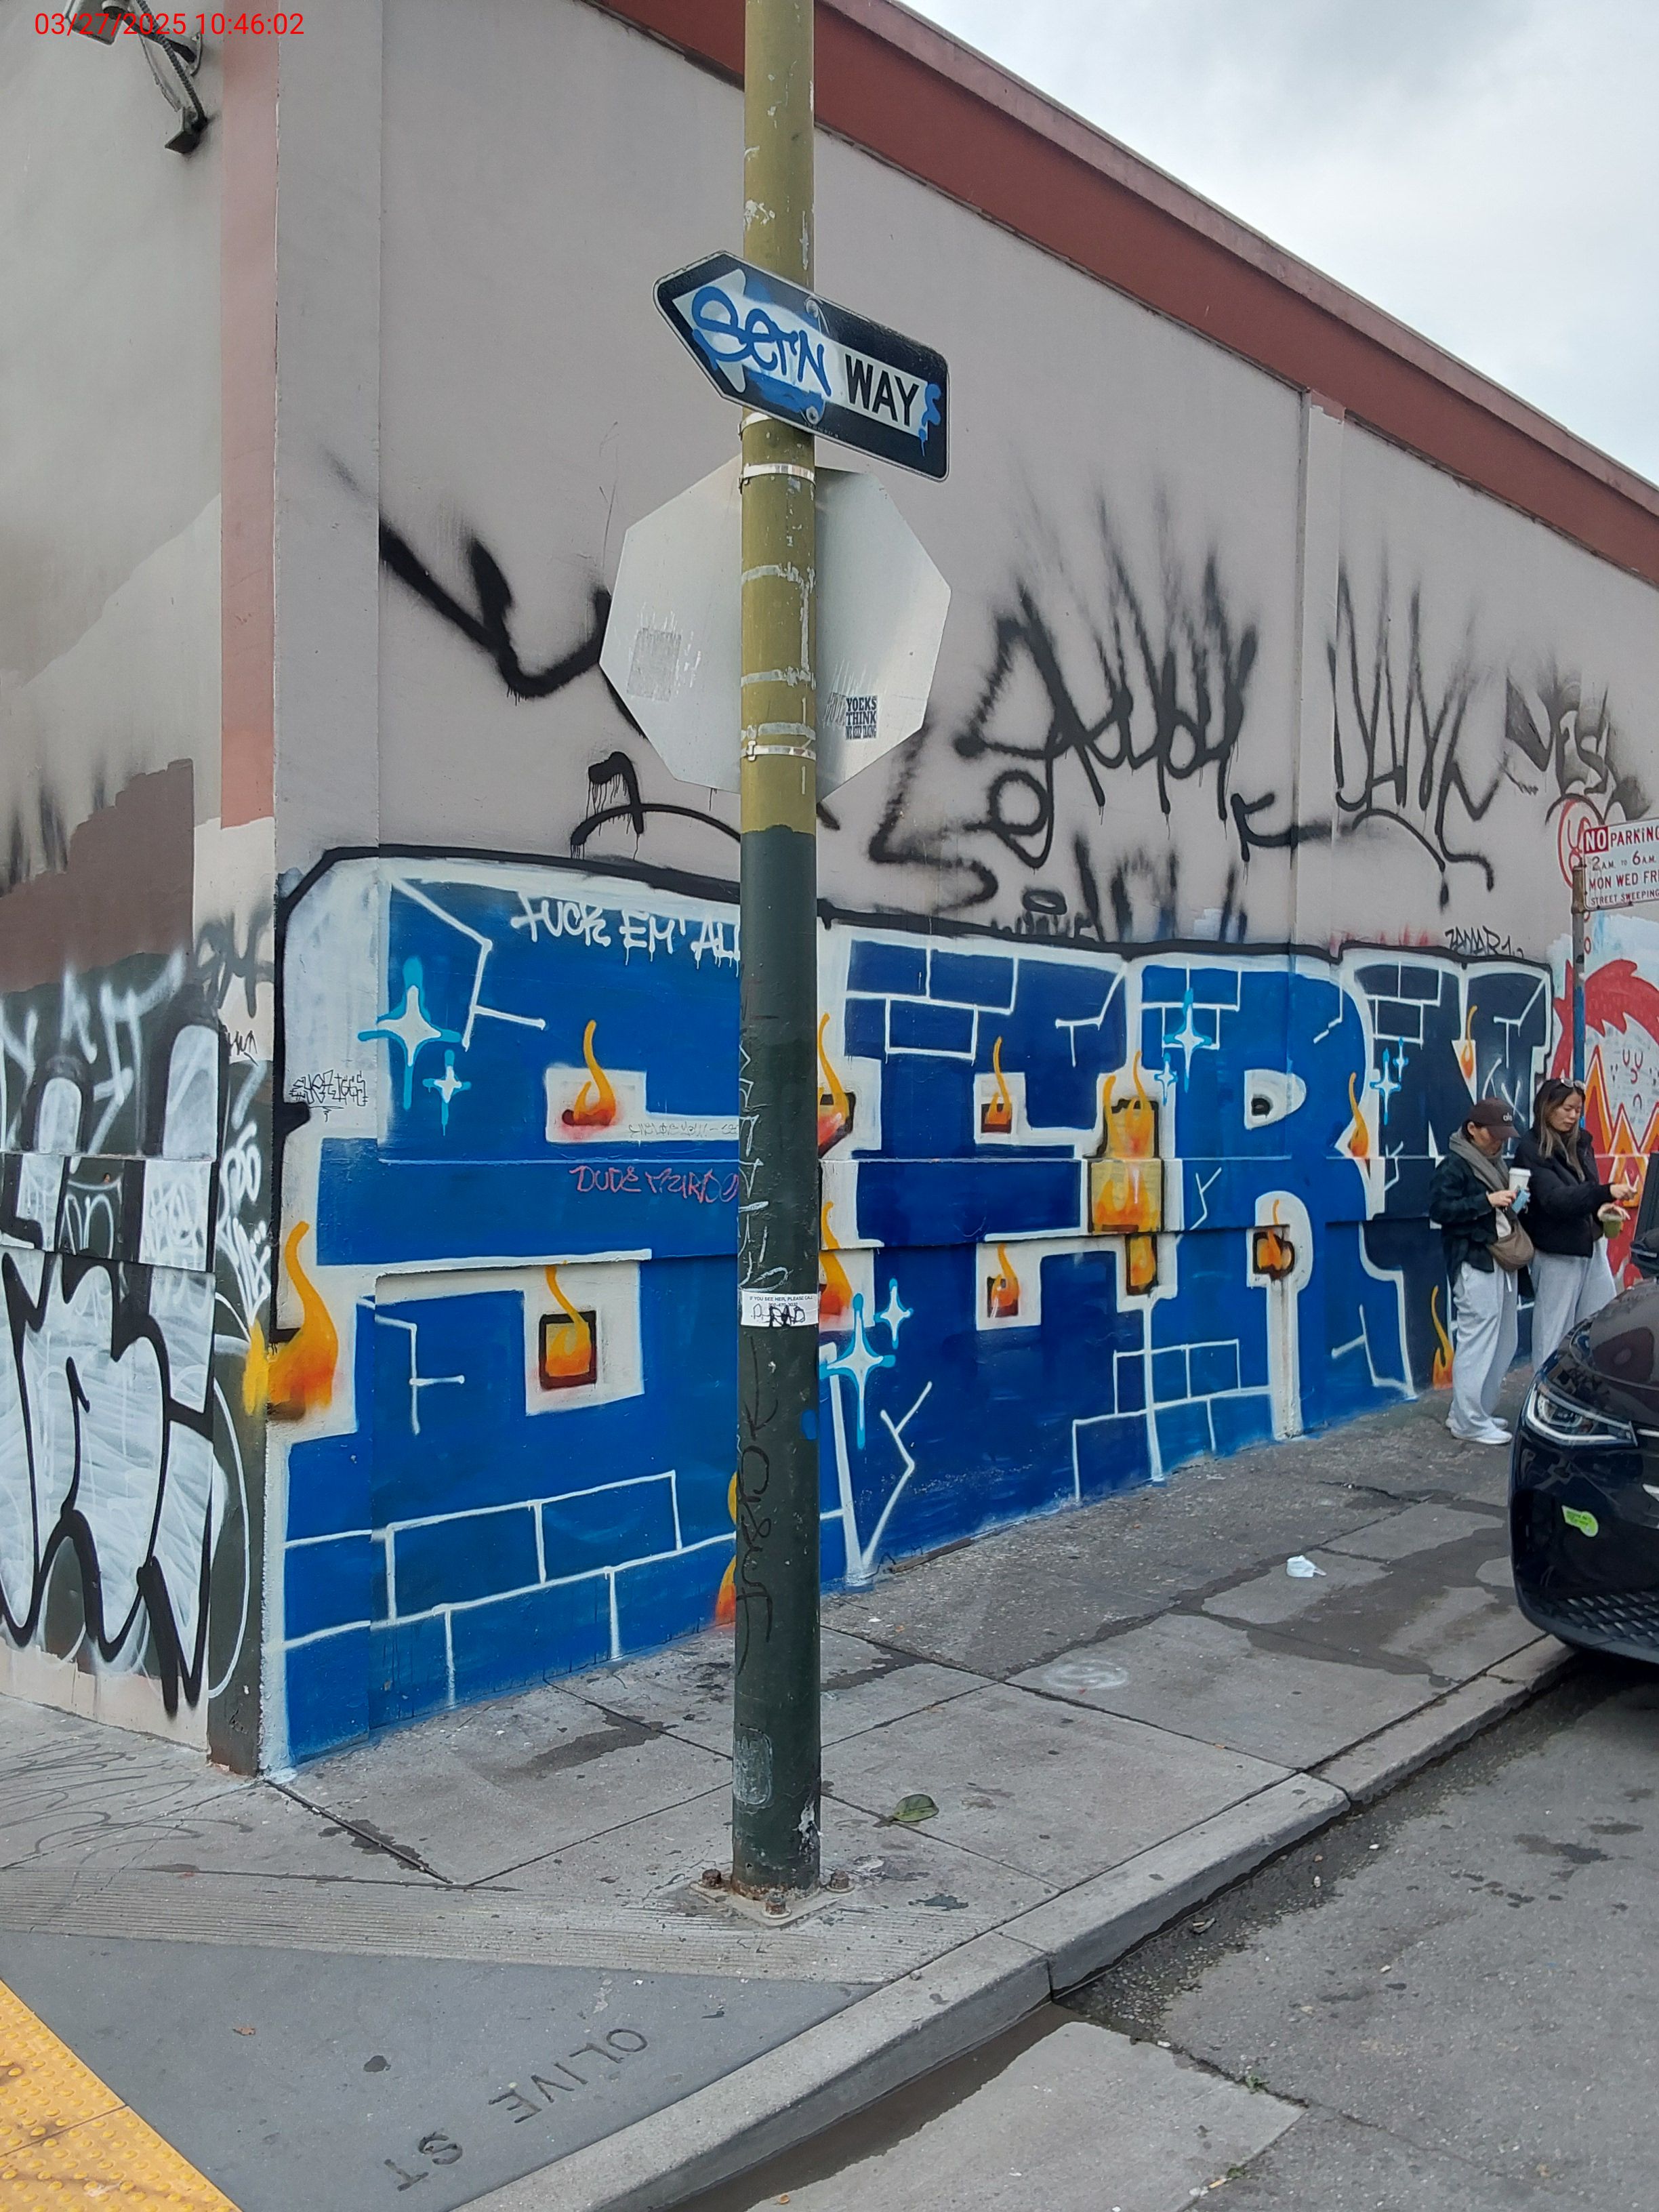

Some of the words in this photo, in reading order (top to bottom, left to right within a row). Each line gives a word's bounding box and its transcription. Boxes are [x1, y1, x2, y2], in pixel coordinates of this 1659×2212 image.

[844, 354, 920, 428] WAY
[846, 710, 876, 726] THINK
[1585, 829, 1607, 852] NO
[1589, 876, 1612, 890] MON
[1616, 872, 1639, 888] WED
[1591, 894, 1617, 905] STREET
[487, 2028, 648, 2124] OLIVE
[383, 2131, 464, 2192] ST
